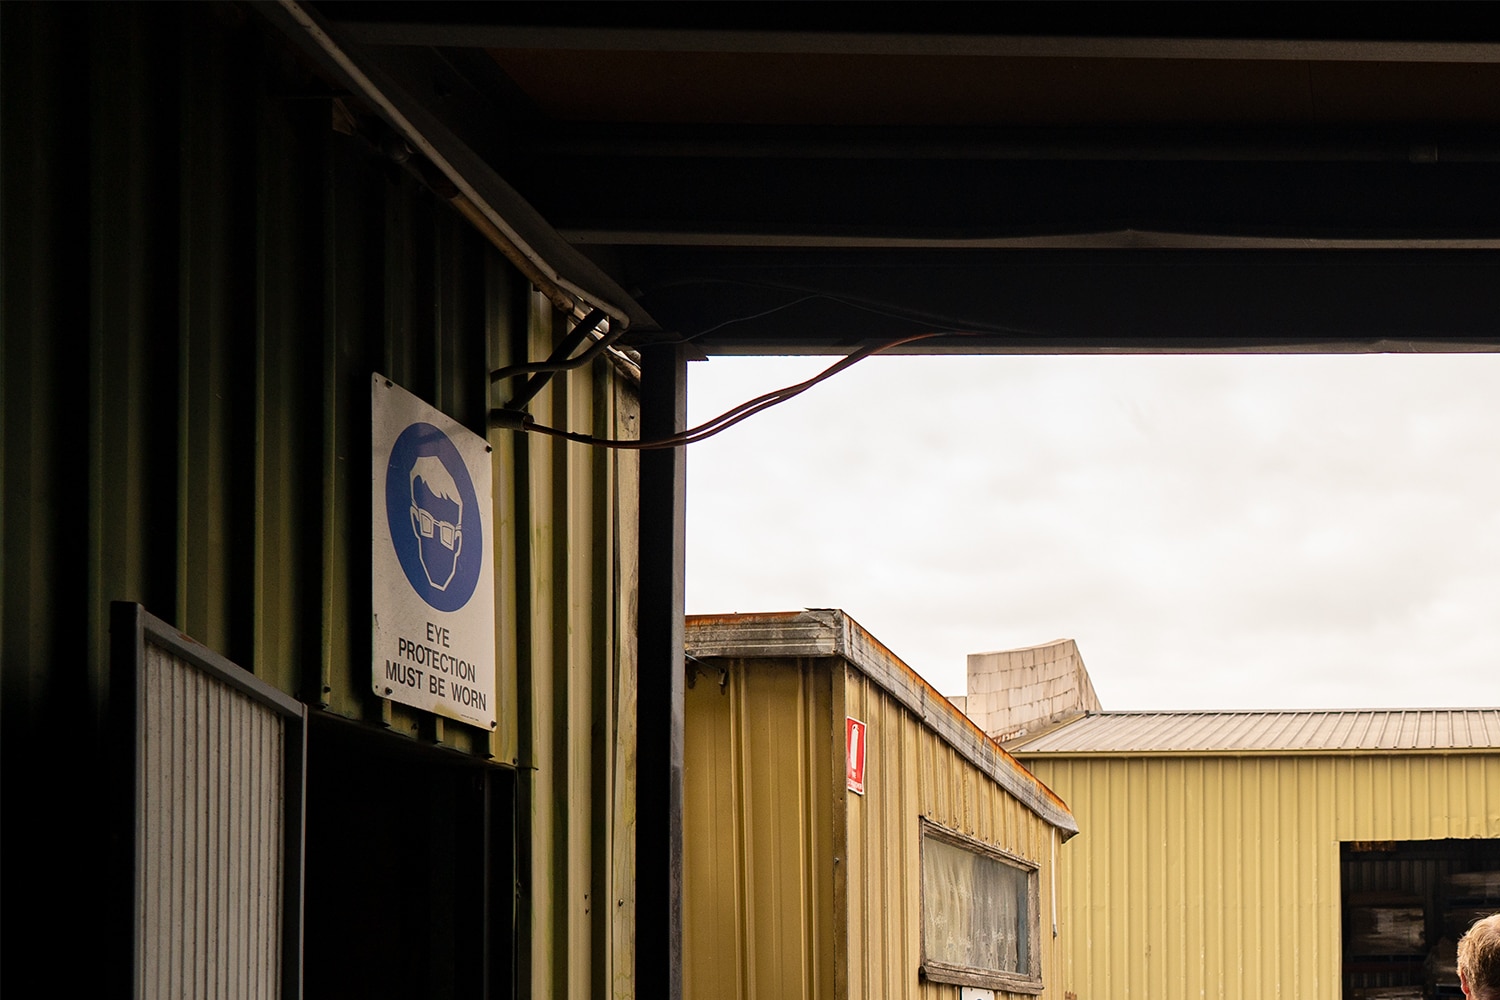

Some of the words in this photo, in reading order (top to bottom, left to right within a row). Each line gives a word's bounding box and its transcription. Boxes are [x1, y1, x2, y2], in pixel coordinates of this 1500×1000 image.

[426, 622, 450, 648] EYE
[398, 637, 476, 683] PROTECTION
[385, 660, 424, 689] MUST
[429, 674, 446, 697] BE
[451, 681, 487, 711] WORN
